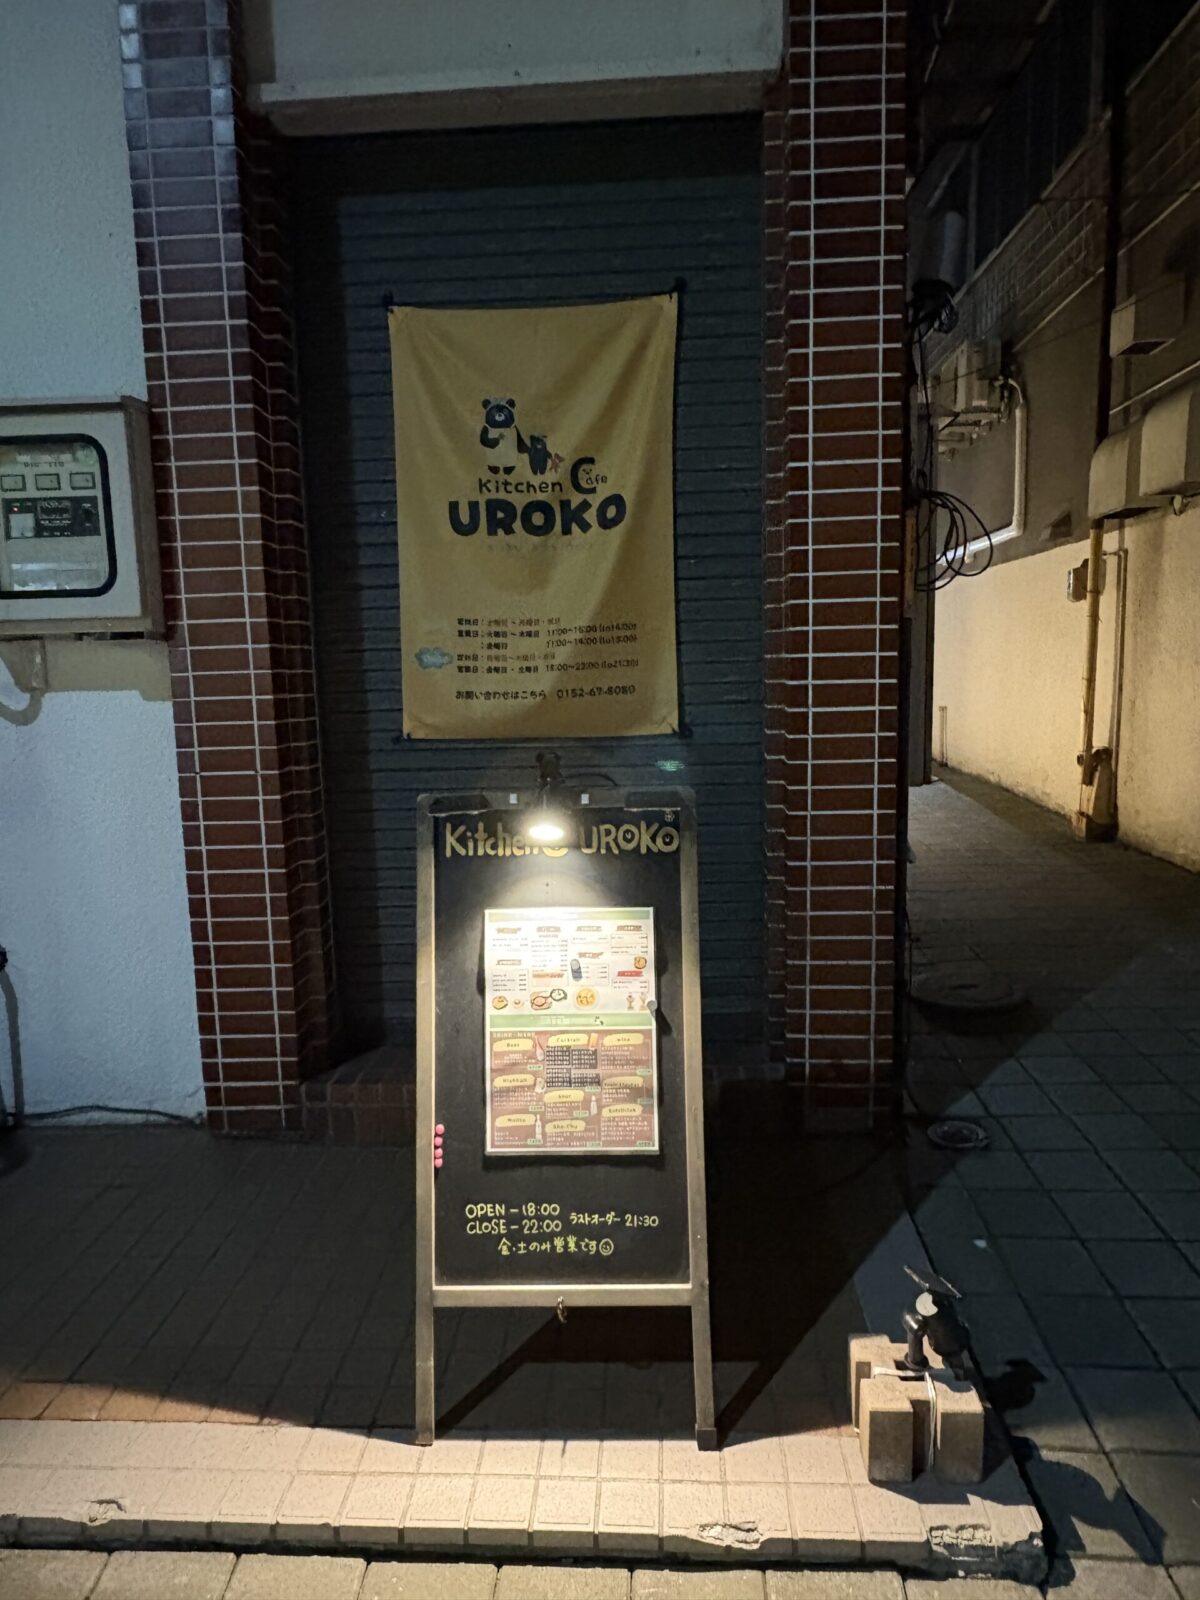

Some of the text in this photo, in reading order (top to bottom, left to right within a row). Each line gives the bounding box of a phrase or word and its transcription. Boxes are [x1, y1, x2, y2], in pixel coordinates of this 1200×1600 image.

[478, 478, 563, 495] Kitchen
[448, 493, 627, 537] UROKO
[455, 689, 546, 700] お問い合わせはこちら
[579, 821, 680, 856] UROKO
[465, 1203, 506, 1219] OPEN
[522, 1202, 561, 1217] 18:00
[522, 1219, 562, 1234] 22:00
[624, 1213, 660, 1228] 21:30
